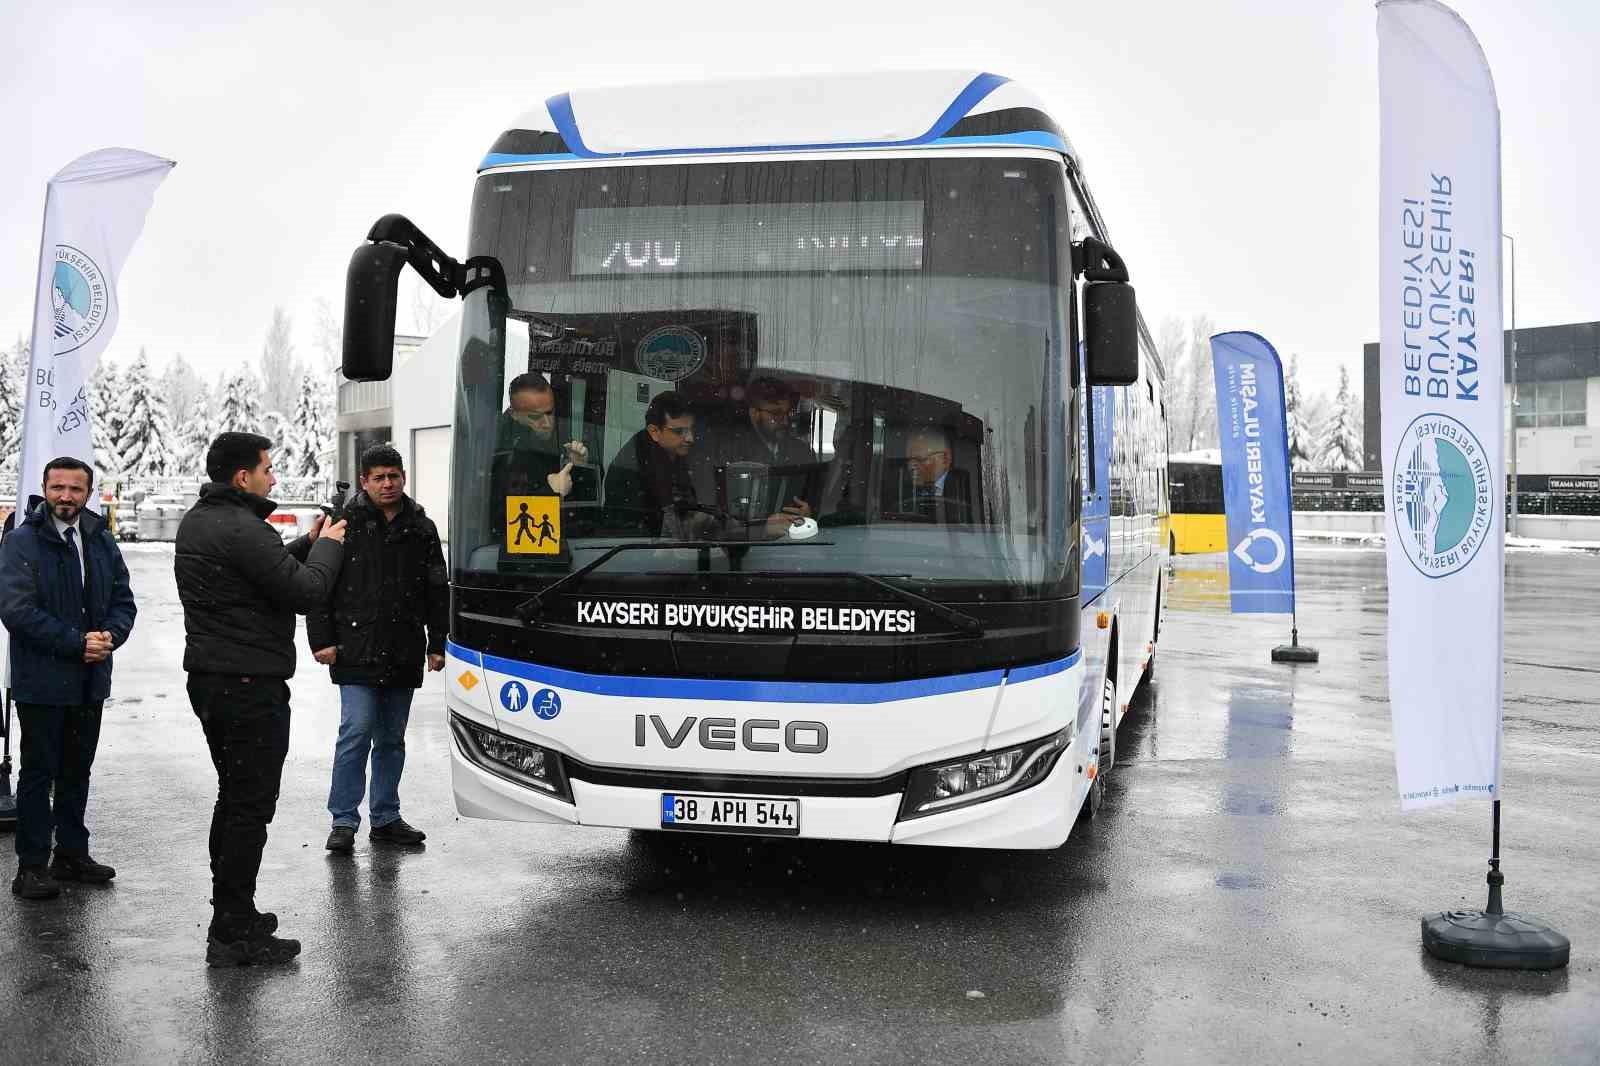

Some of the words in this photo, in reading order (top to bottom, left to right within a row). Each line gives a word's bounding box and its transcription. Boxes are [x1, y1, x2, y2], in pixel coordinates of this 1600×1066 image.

[665, 604, 794, 632] BÜYÜKŞEHİR
[635, 715, 829, 754] IVECO
[675, 799, 697, 820] 38
[711, 801, 746, 823] APH
[756, 803, 793, 825] 544
